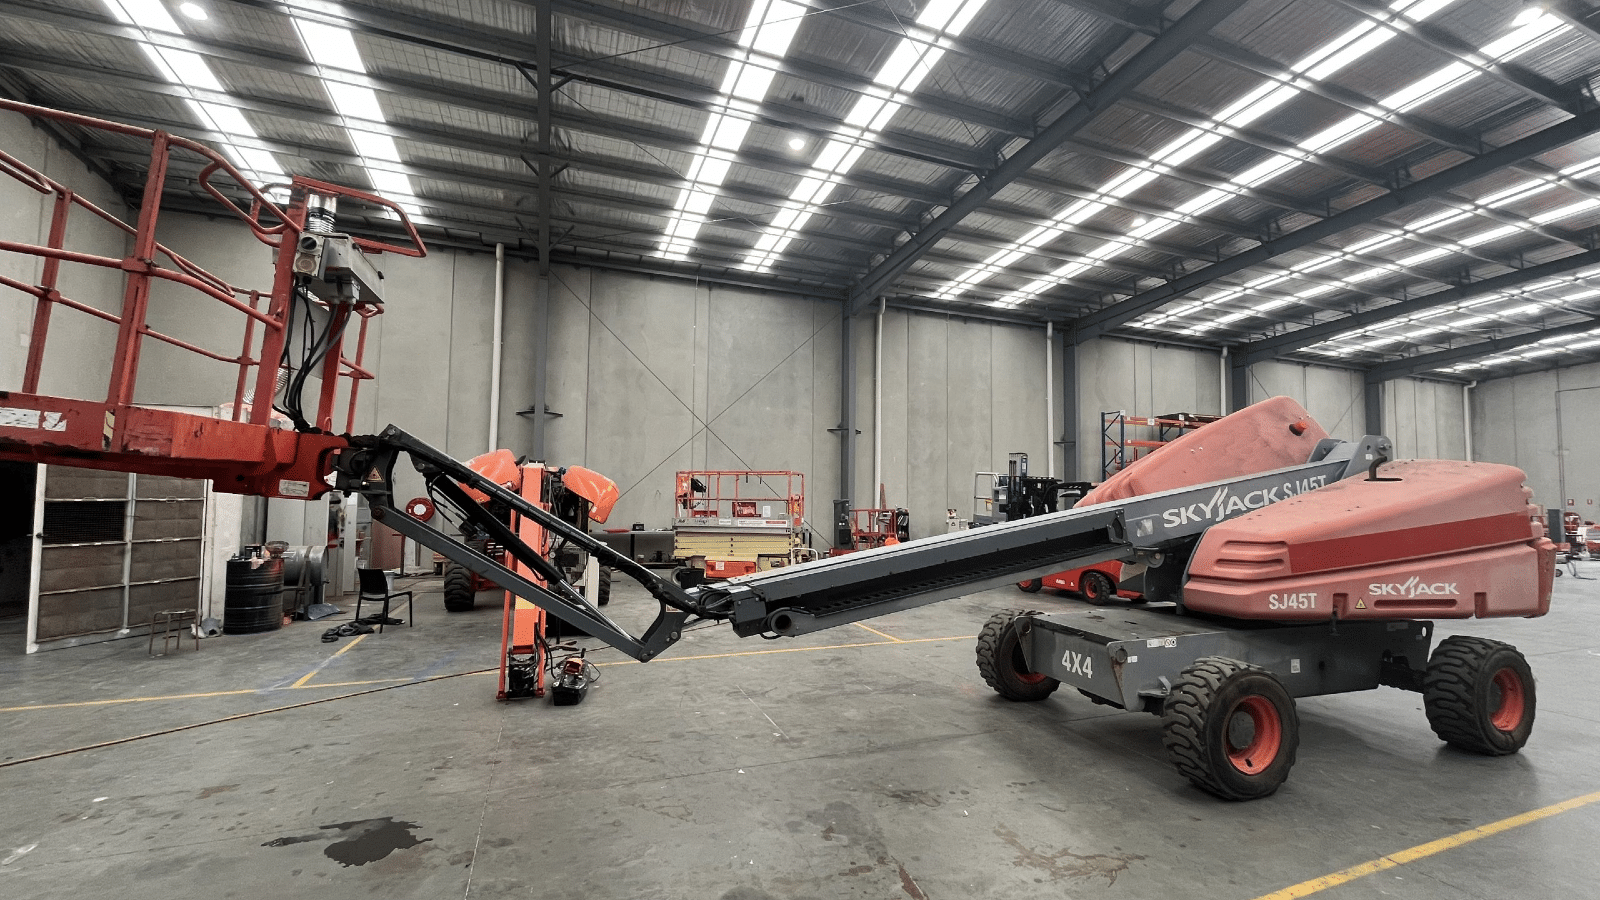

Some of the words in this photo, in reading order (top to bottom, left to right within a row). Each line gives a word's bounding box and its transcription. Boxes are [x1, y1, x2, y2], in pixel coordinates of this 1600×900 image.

[1162, 486, 1282, 528] SKYJACK
[1369, 576, 1460, 598] SKYJACK
[1268, 593, 1317, 609] SJ45T
[1061, 650, 1093, 679] 4X4
